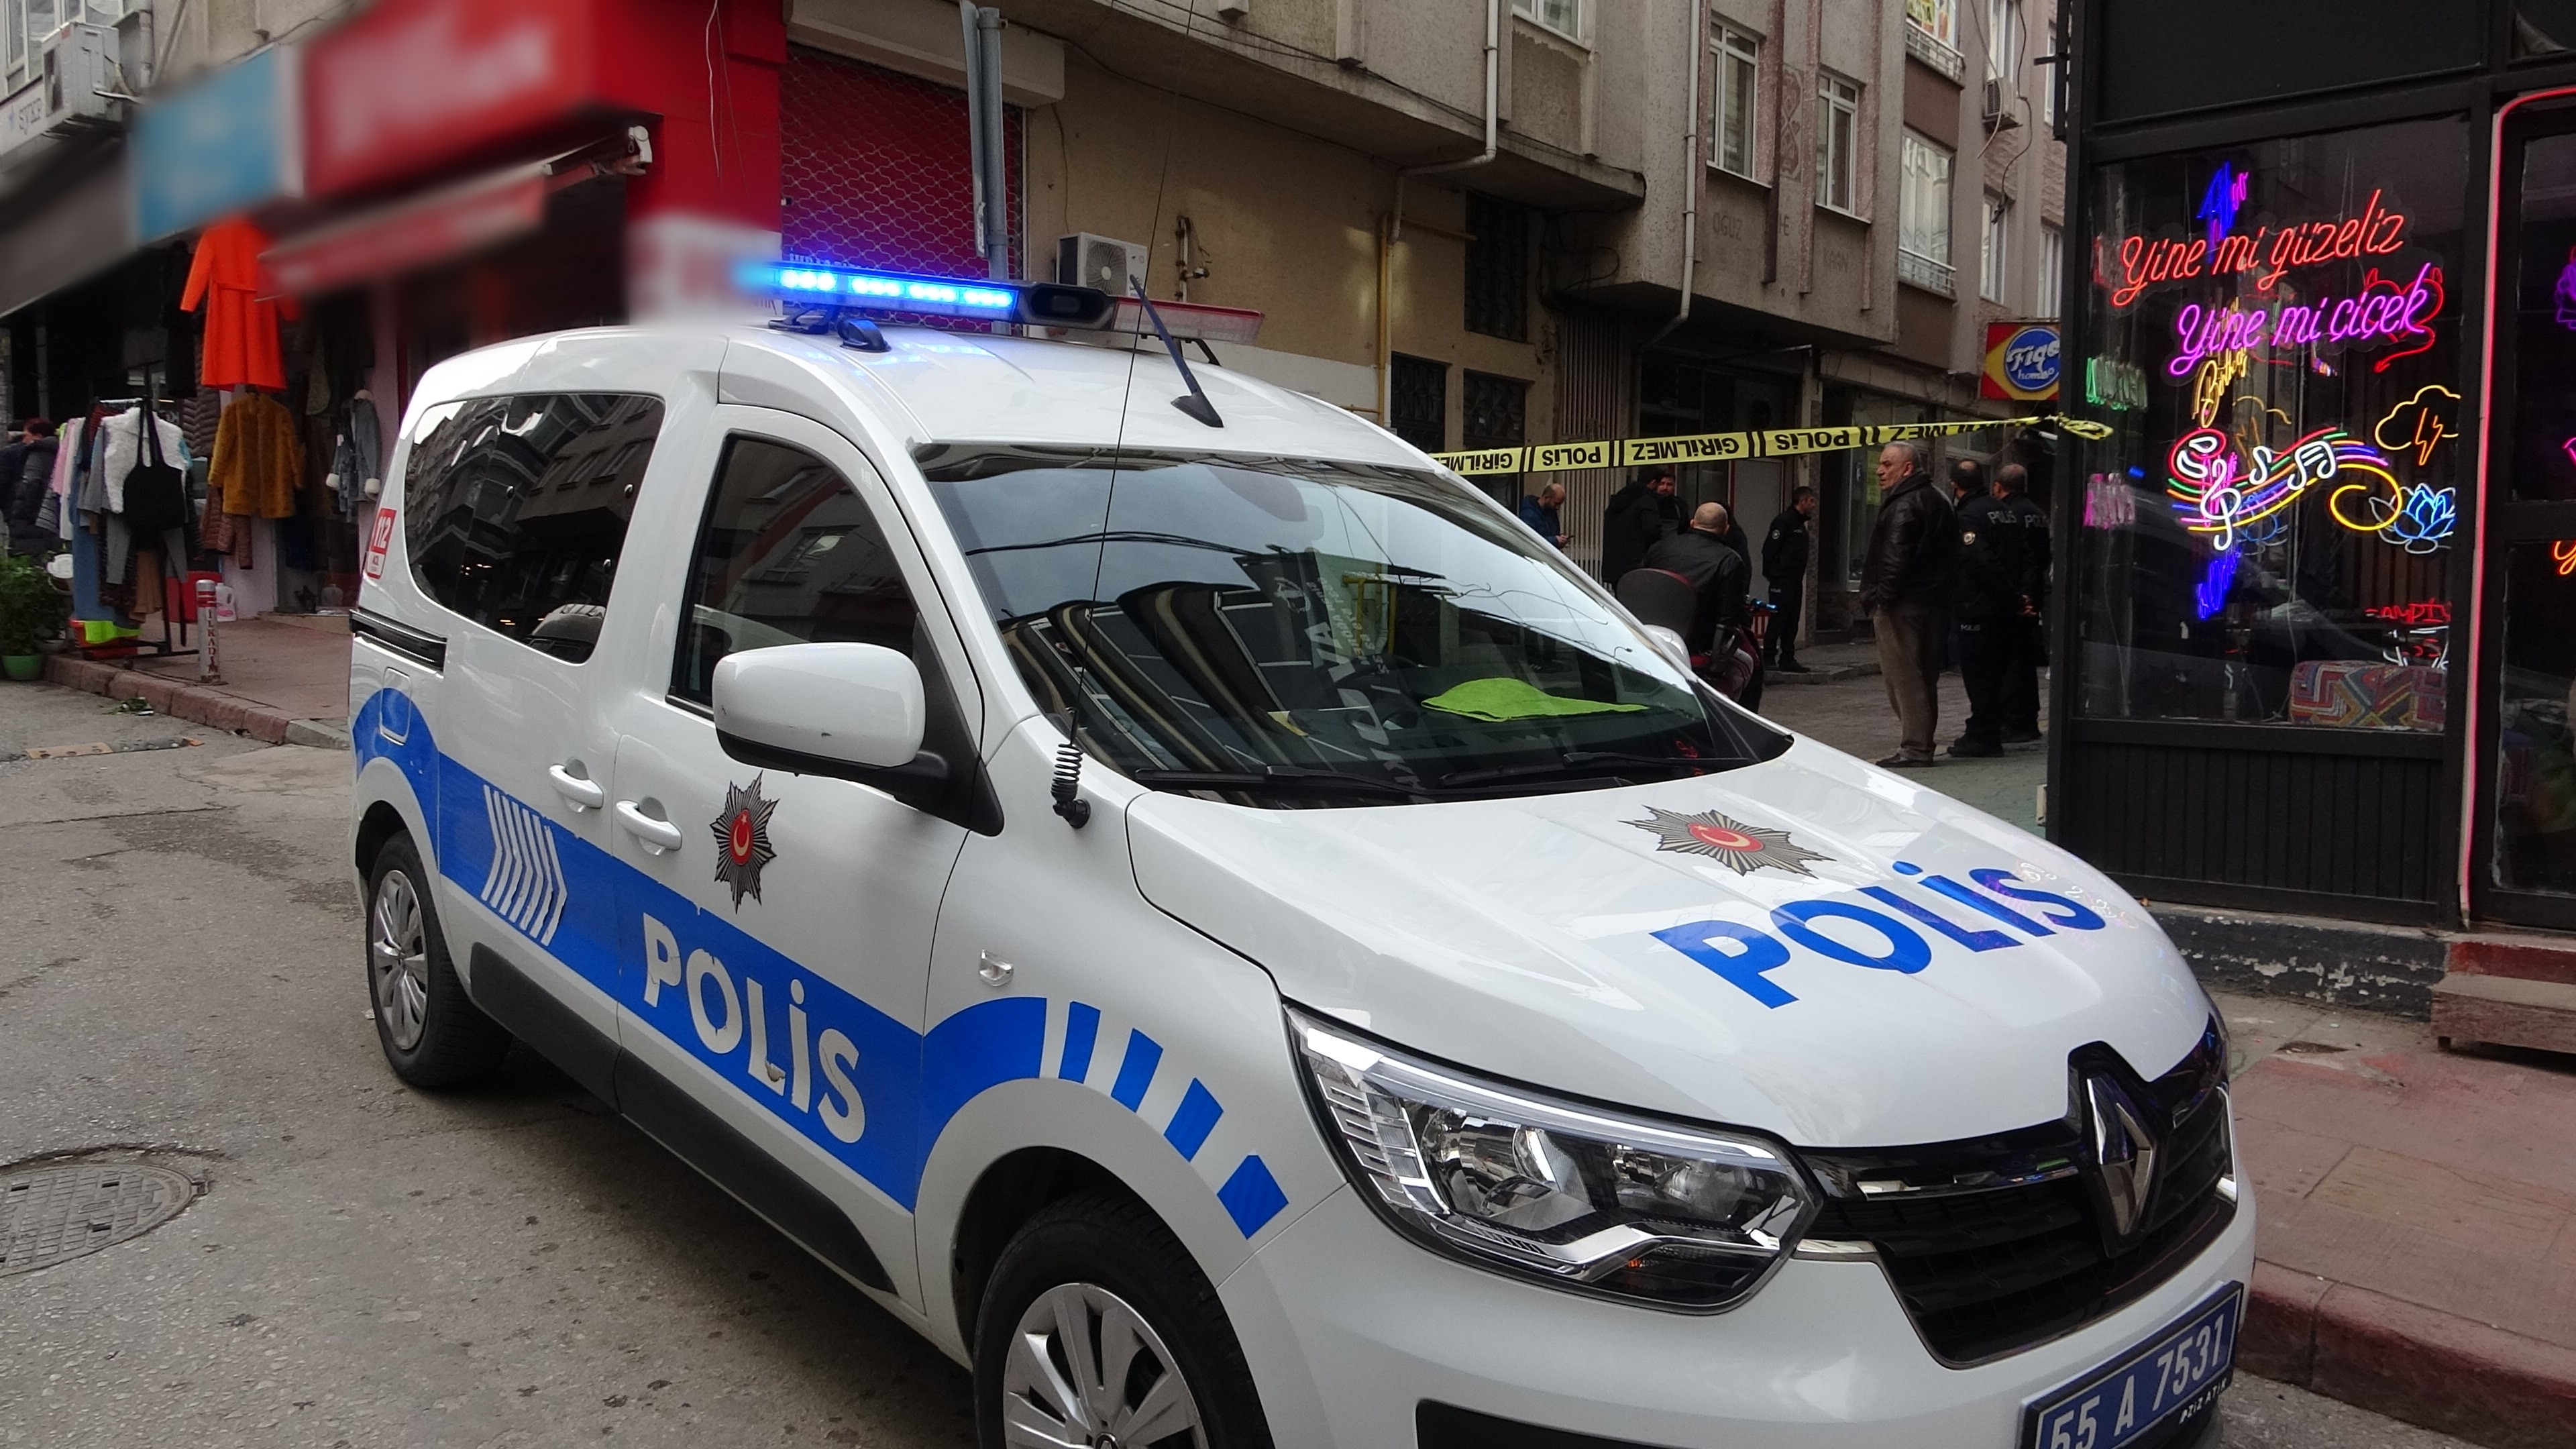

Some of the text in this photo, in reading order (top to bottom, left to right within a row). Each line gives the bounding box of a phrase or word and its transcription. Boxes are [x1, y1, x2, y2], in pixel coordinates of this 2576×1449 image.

[2212, 227, 2265, 276] mi
[2258, 189, 2404, 290] güzeliz
[2271, 297, 2328, 346] mi
[1648, 860, 2106, 1010] POLİS
[643, 912, 866, 1144] POLİS
[2050, 1313, 2224, 1449] 55 A 7531
